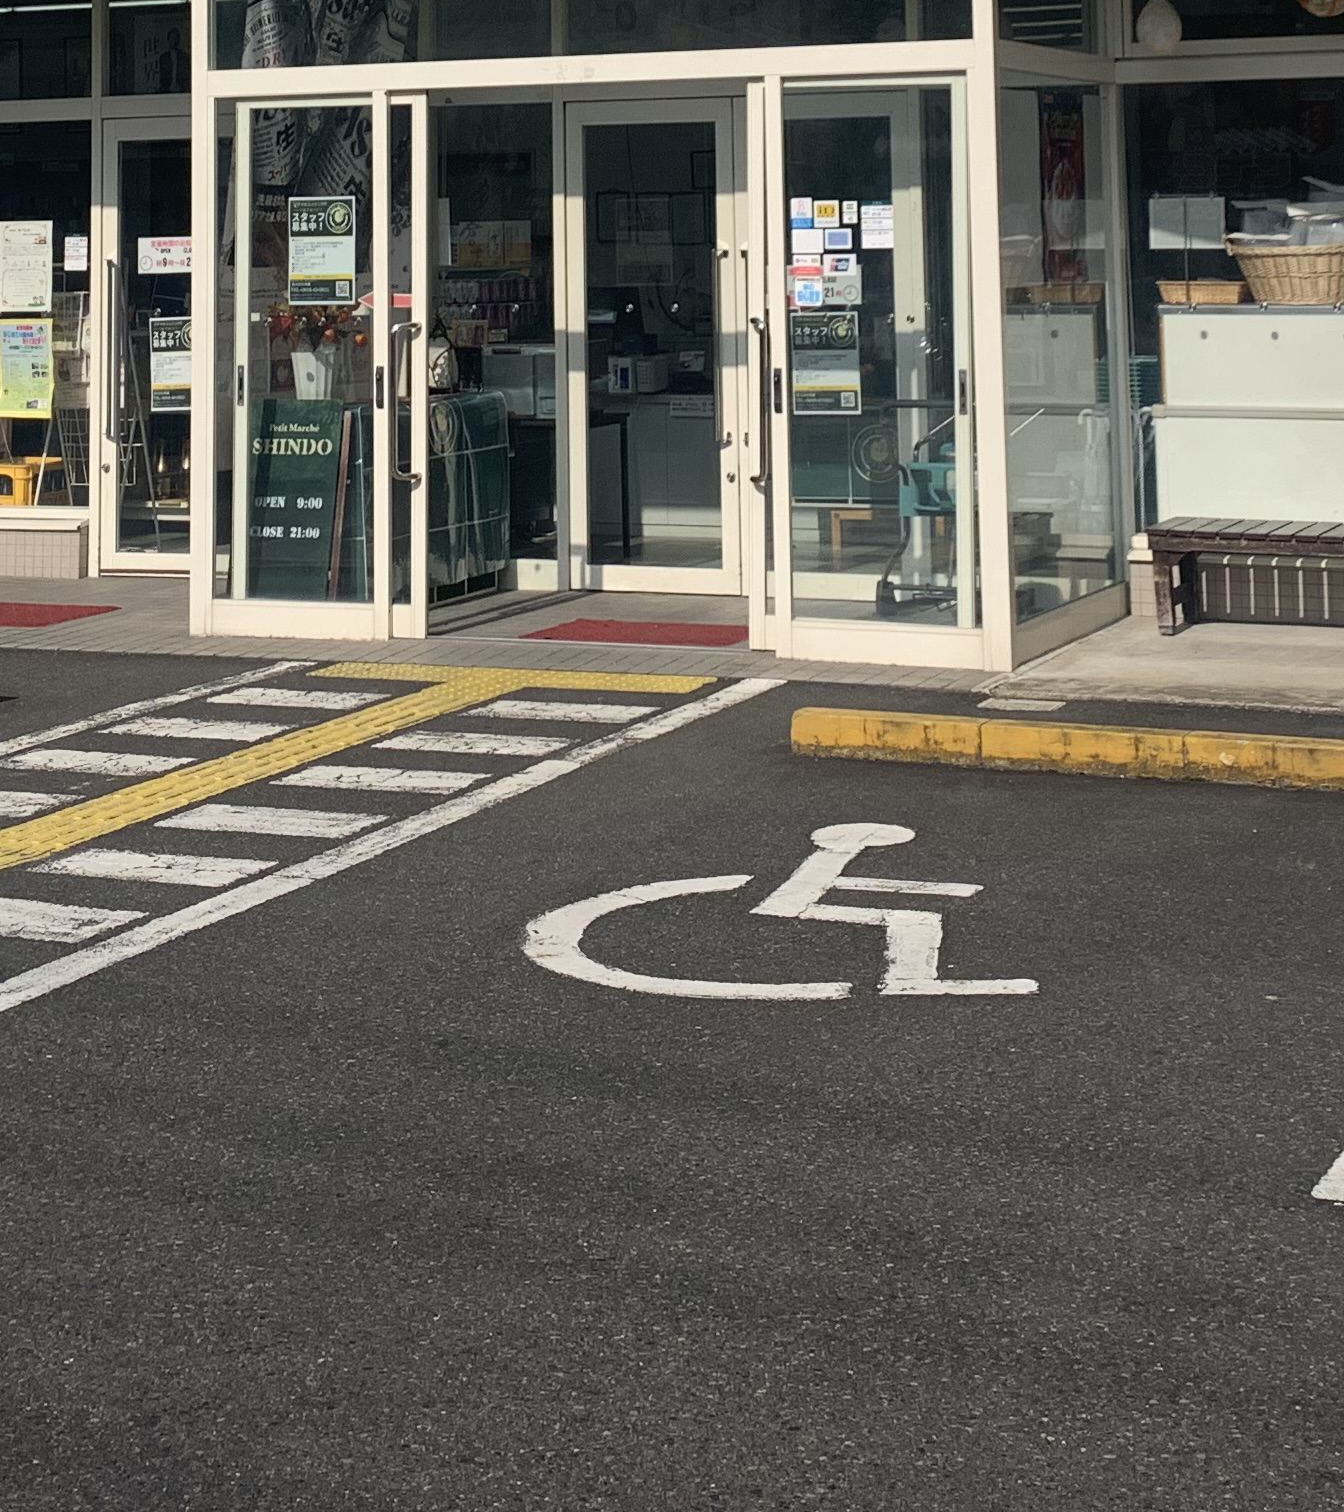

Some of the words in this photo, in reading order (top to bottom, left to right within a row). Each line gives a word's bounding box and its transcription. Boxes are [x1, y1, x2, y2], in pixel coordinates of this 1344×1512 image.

[292, 212, 325, 222] スタッフ
[153, 330, 181, 339] スタッフ
[795, 326, 828, 336] スタッフ
[252, 438, 333, 456] SHINDO
[255, 496, 286, 508] OPEN
[296, 497, 323, 509] 9:00
[250, 525, 285, 538] CLOSE
[289, 526, 321, 539] 21:00
